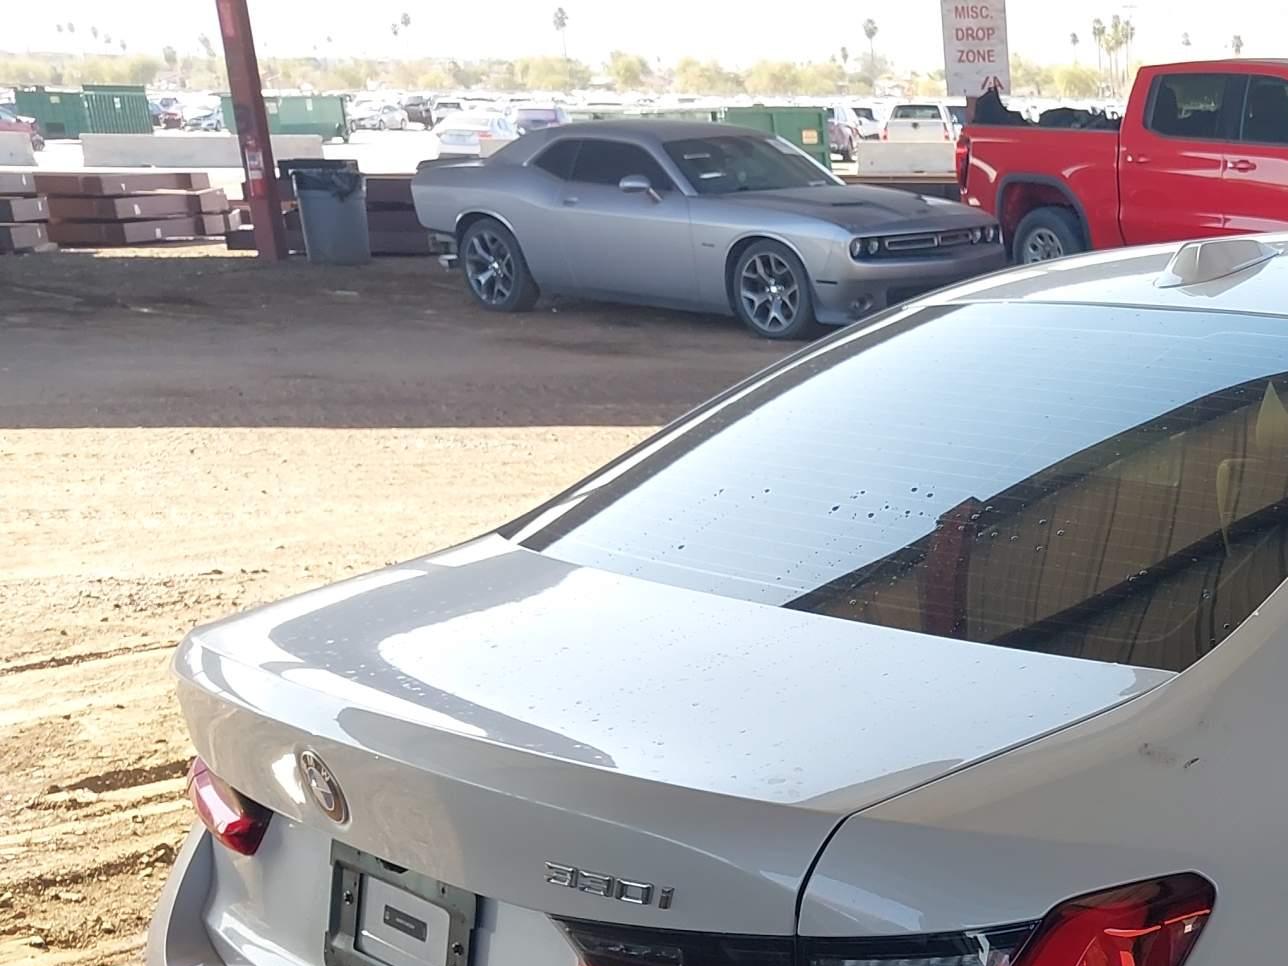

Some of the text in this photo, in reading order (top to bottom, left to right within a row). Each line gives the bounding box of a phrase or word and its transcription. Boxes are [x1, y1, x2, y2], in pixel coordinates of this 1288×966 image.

[954, 5, 993, 20] MISC.
[955, 26, 995, 41] DROP
[956, 48, 996, 63] ZONE
[544, 860, 675, 910] 330i
